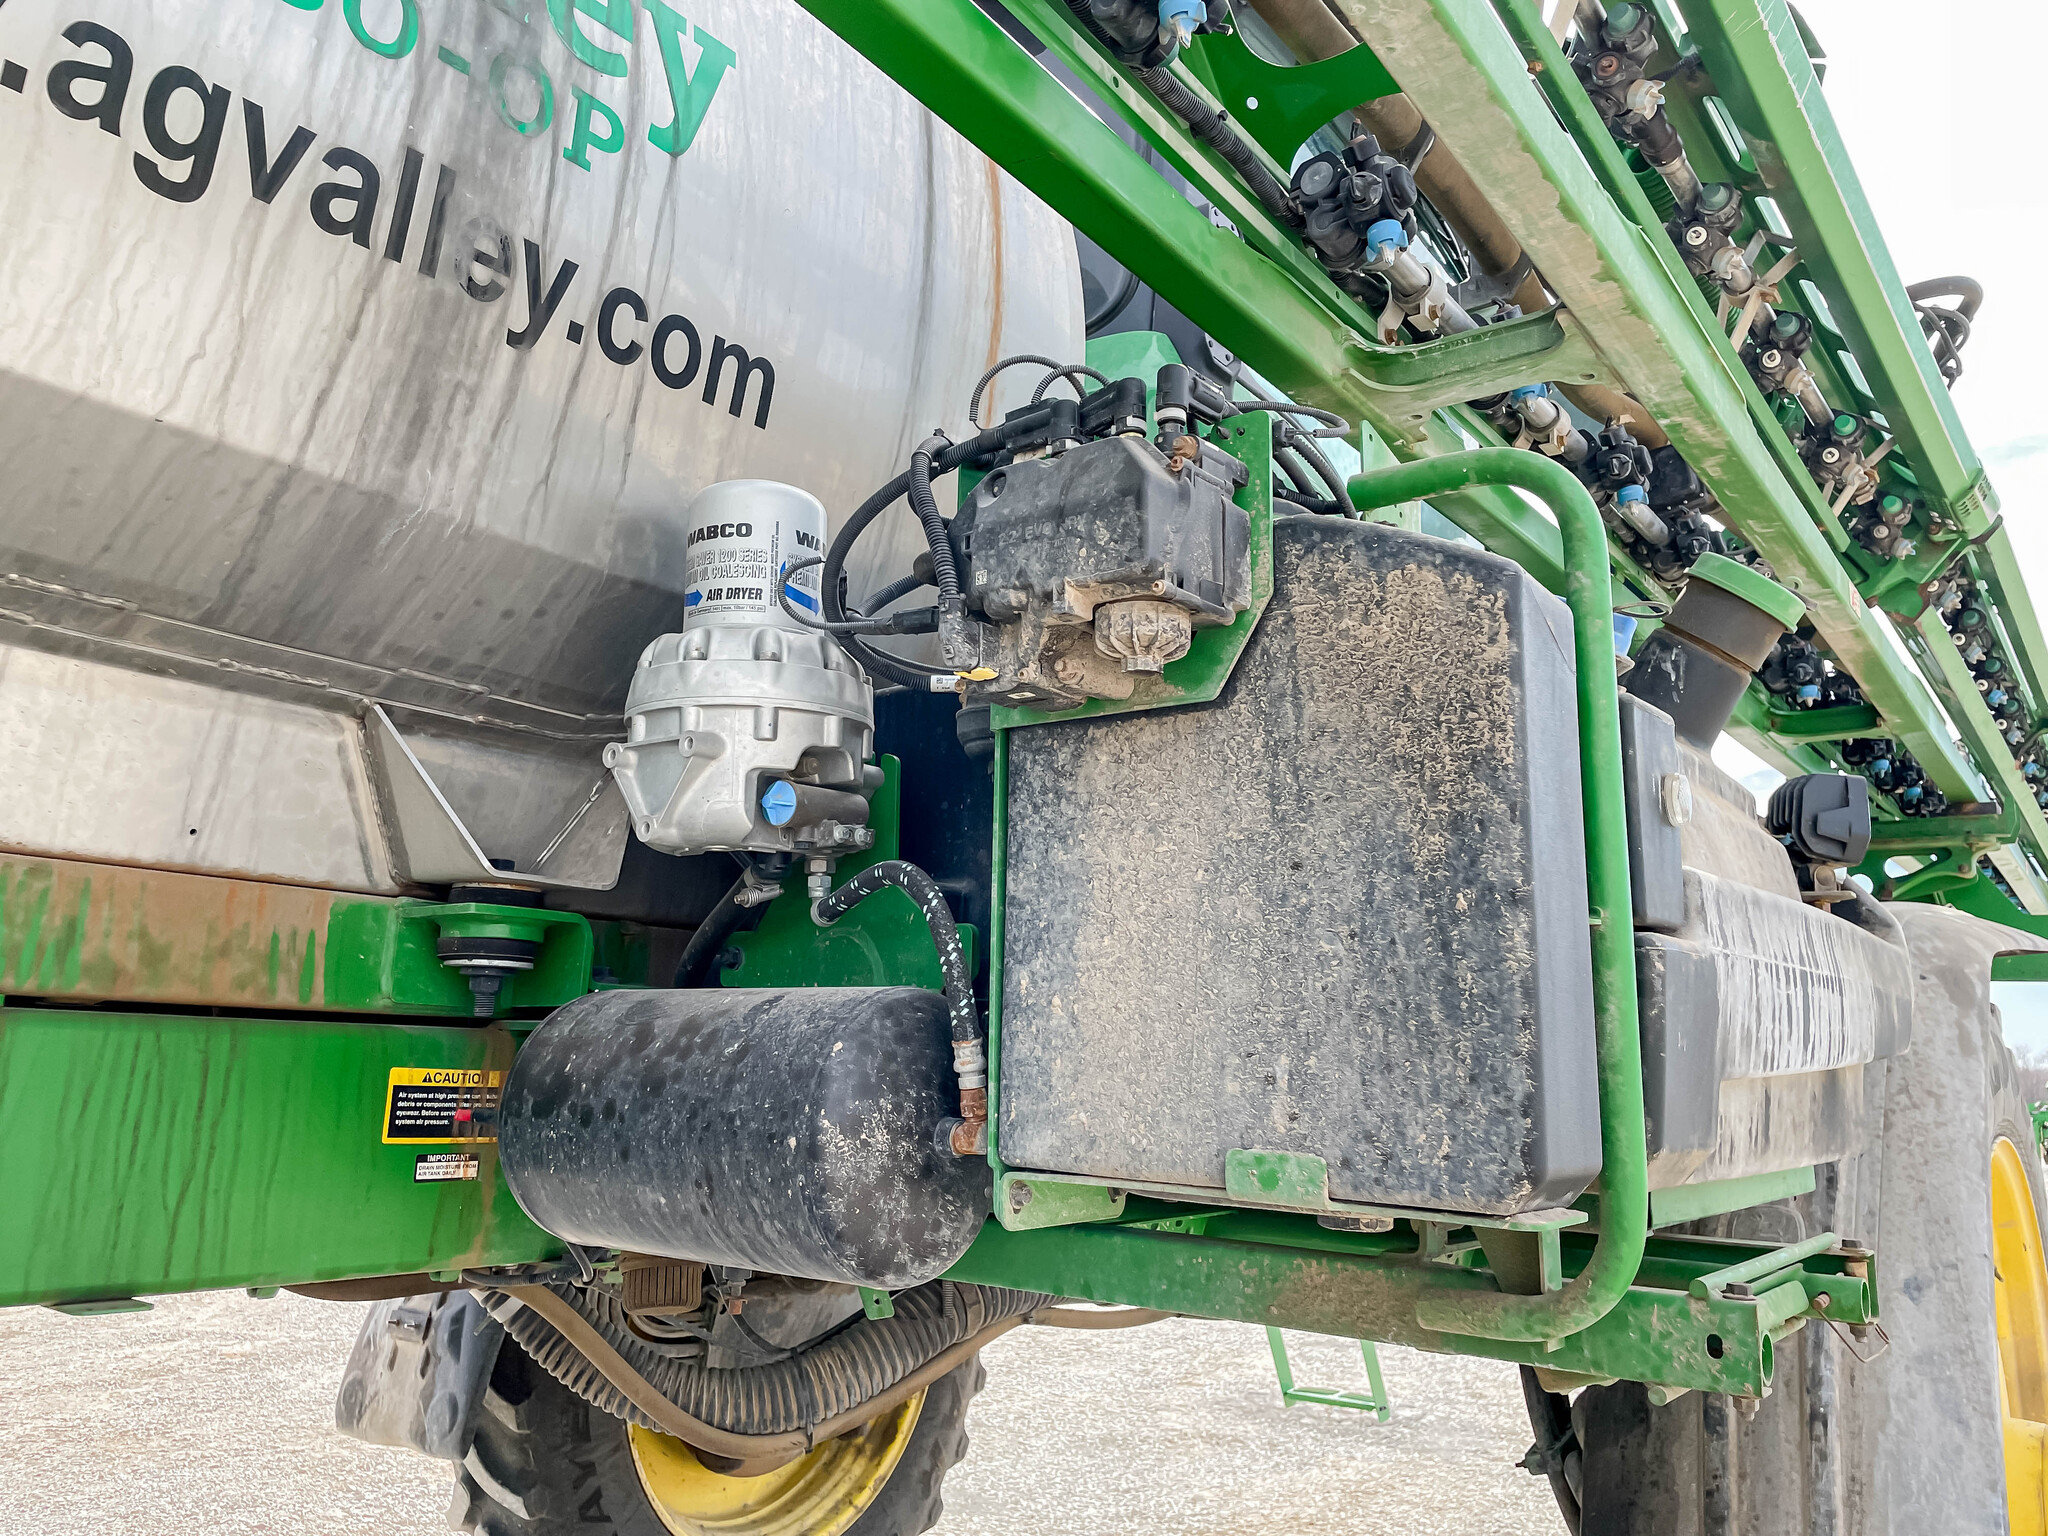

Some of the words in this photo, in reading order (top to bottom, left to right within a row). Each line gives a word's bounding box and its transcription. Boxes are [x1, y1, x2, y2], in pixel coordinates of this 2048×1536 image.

[283, 0, 625, 172] O-OP
[545, 0, 737, 157] ey
[0, 0, 776, 430] .agvalley.com
[687, 522, 753, 549] WABCO
[718, 547, 737, 564] 1200
[738, 547, 768, 564] SERIES
[712, 563, 767, 580] COALESCING
[706, 587, 724, 602] AIR
[725, 586, 763, 601] DRYER
[427, 1154, 470, 1162] IMPORTANT
